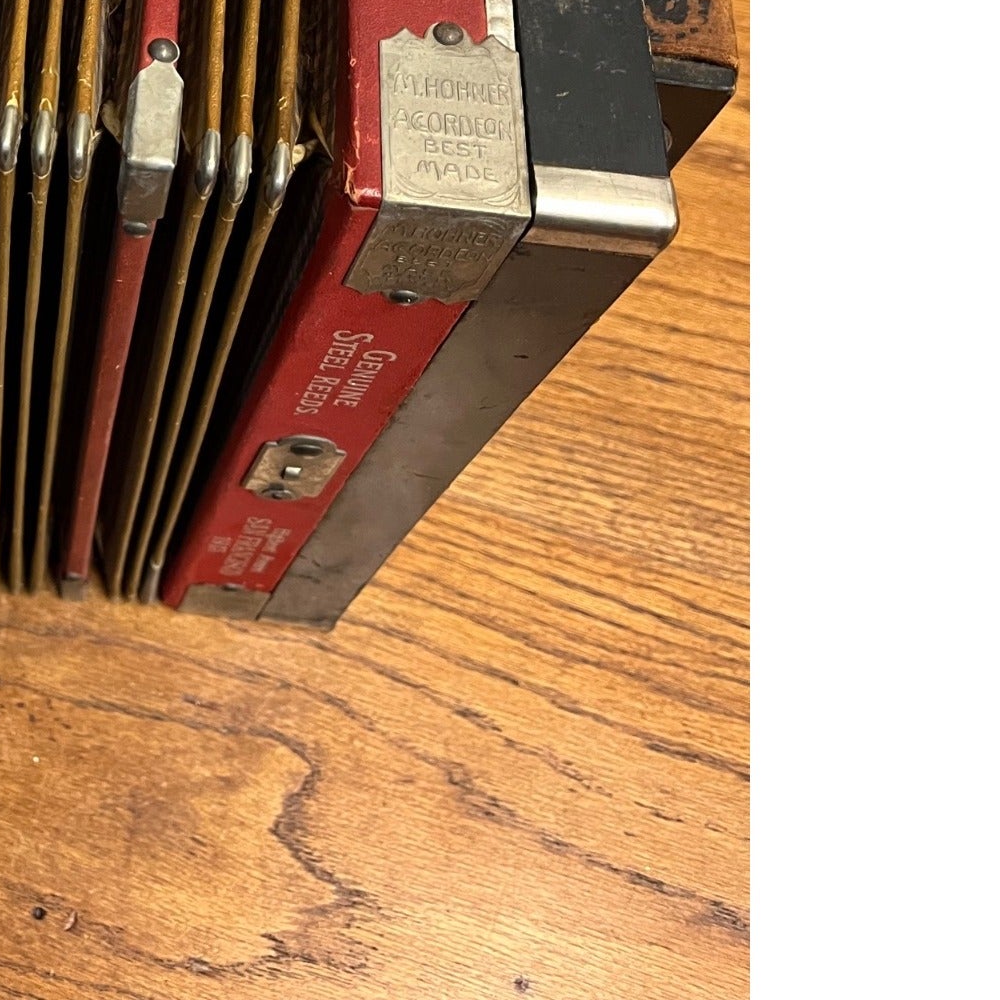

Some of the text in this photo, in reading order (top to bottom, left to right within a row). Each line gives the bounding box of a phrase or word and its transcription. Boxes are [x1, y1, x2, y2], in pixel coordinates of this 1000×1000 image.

[392, 73, 511, 106] M.HOHNER
[424, 138, 489, 159] BEST
[415, 159, 500, 184] MADE
[293, 330, 375, 416] STEEL REEDS.
[333, 349, 398, 408] GENUINE
